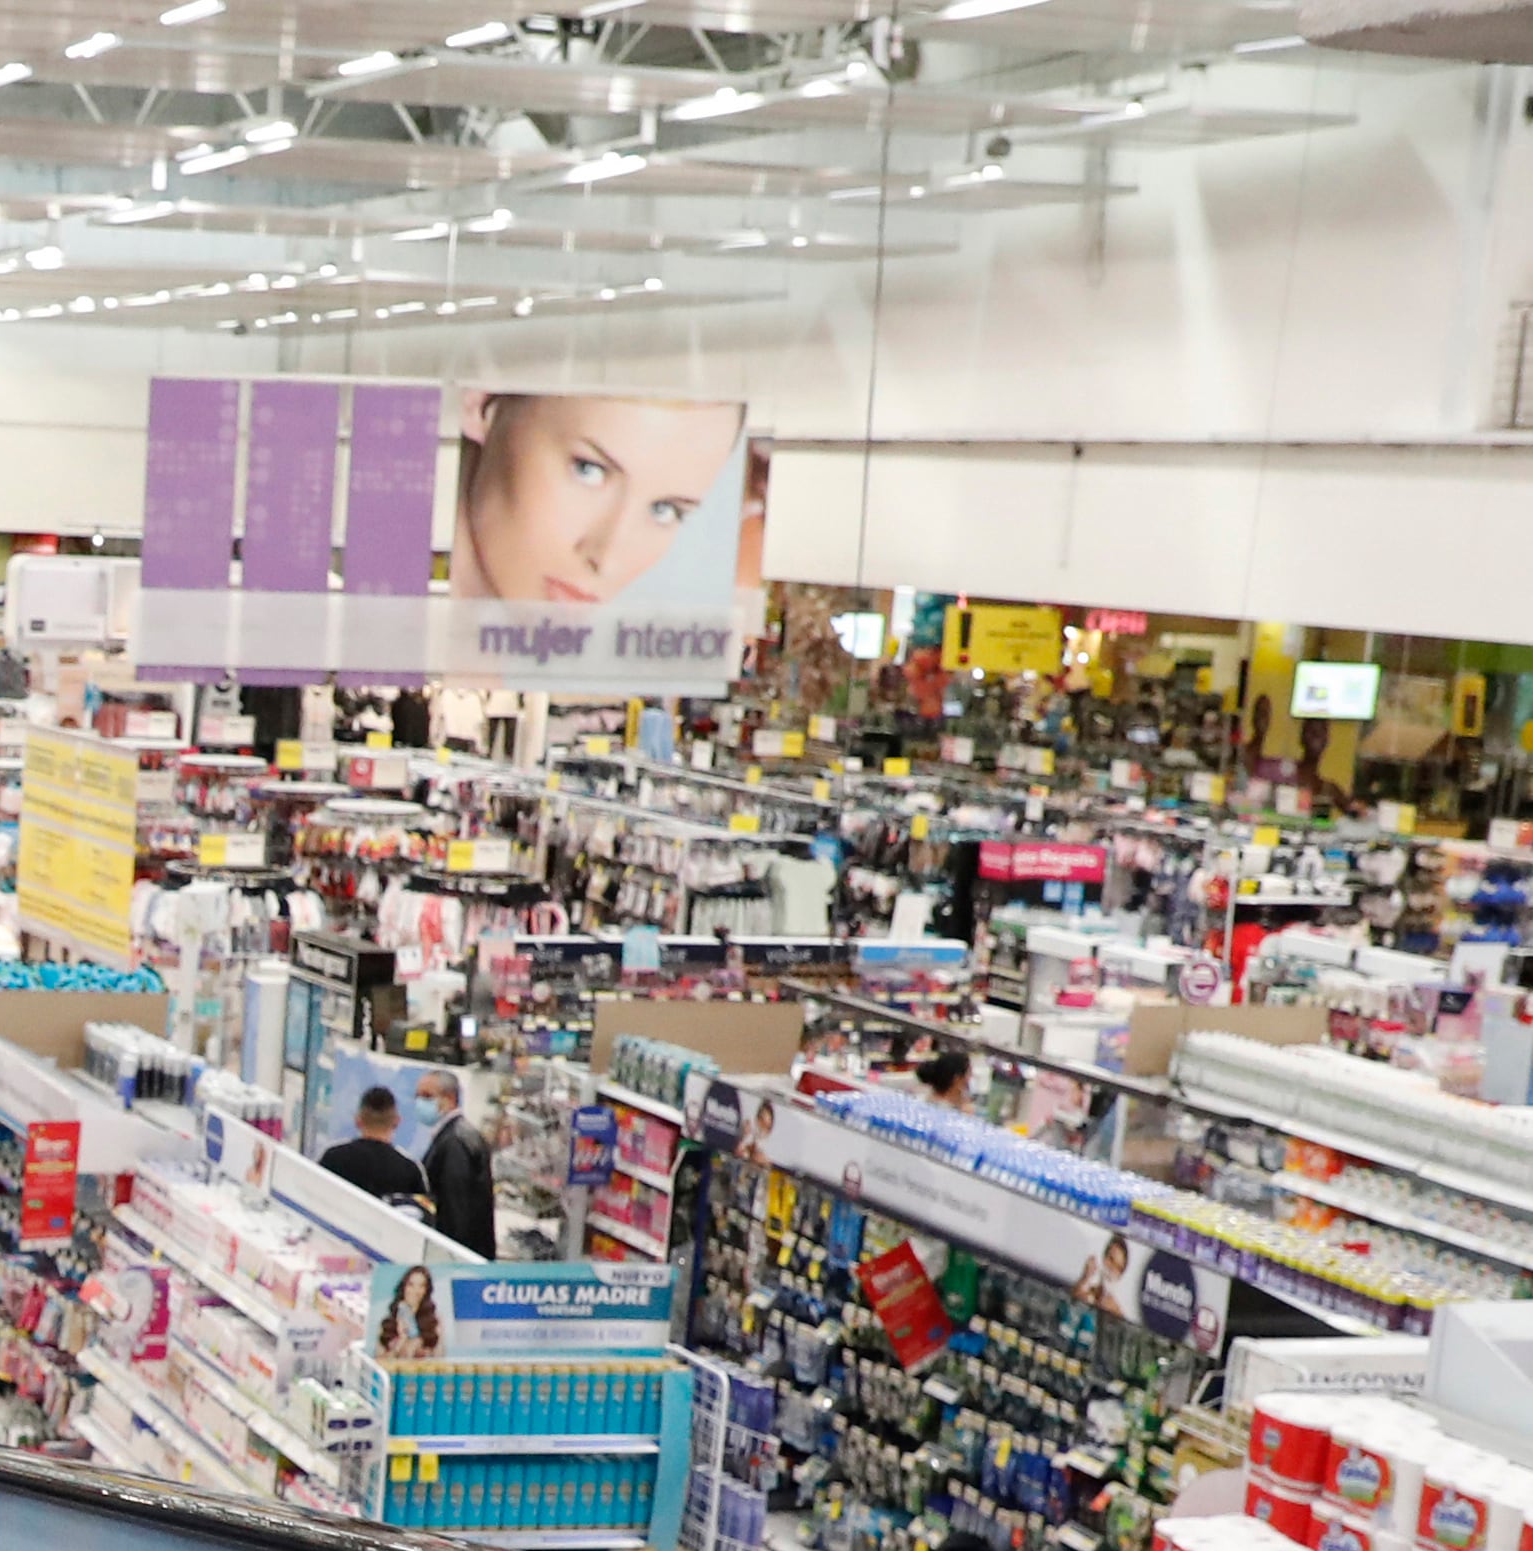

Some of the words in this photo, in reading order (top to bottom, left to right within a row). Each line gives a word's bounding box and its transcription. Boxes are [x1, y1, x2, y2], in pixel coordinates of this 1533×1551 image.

[480, 615, 593, 664] mujer
[614, 614, 734, 661] interior
[610, 1268, 665, 1283] NUEVO
[481, 1283, 571, 1306] CÉLULAS
[574, 1285, 652, 1306] MADRE
